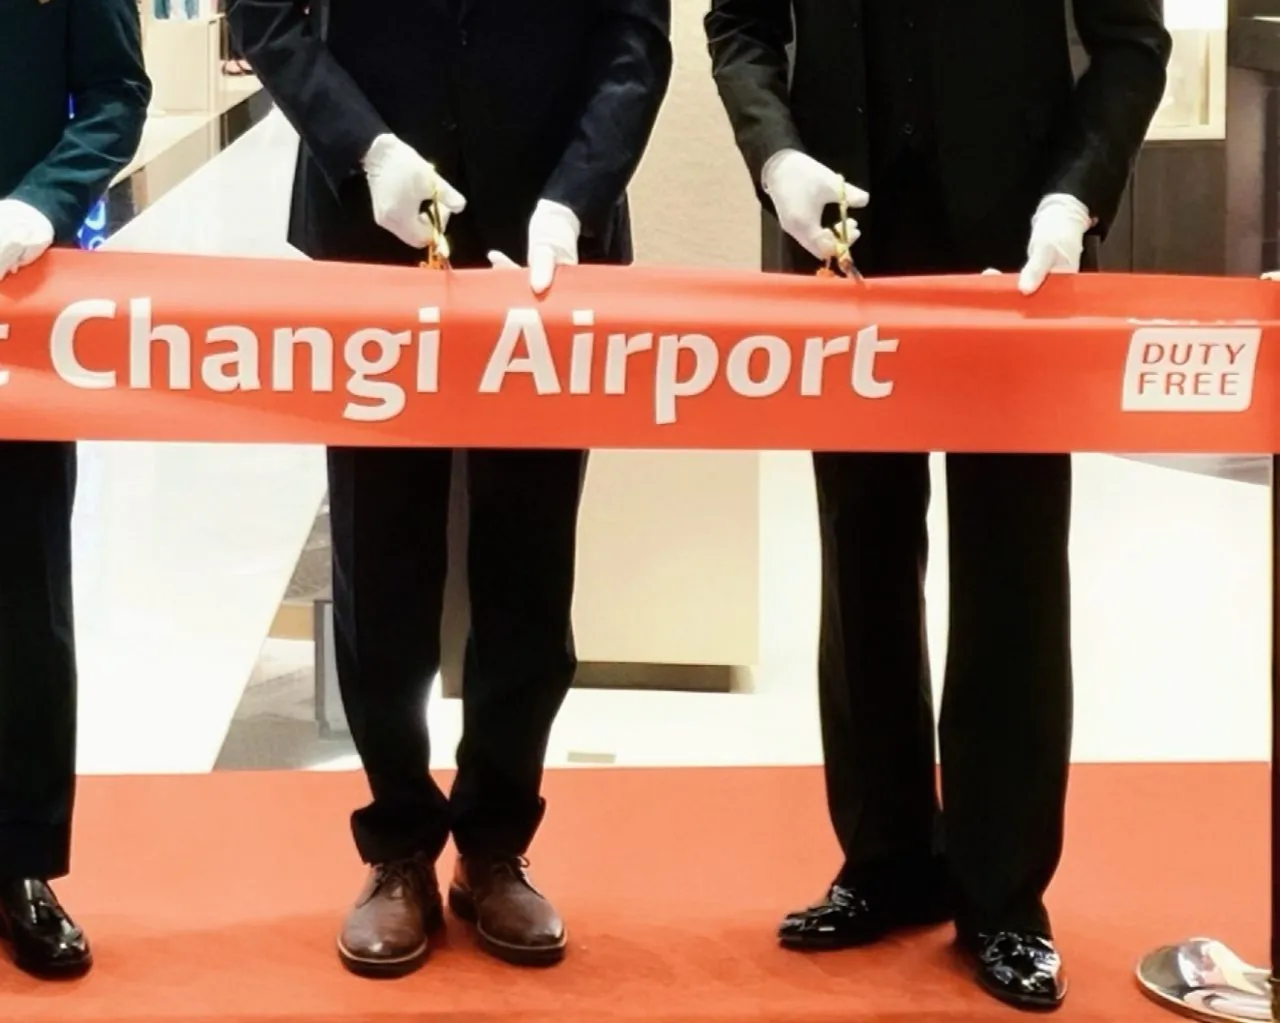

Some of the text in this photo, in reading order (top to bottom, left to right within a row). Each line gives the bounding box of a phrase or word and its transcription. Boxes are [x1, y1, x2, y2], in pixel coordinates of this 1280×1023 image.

[48, 296, 441, 423] Changi
[477, 307, 899, 425] Airport
[1142, 342, 1246, 365] DUTY
[1137, 372, 1240, 396] FREE
